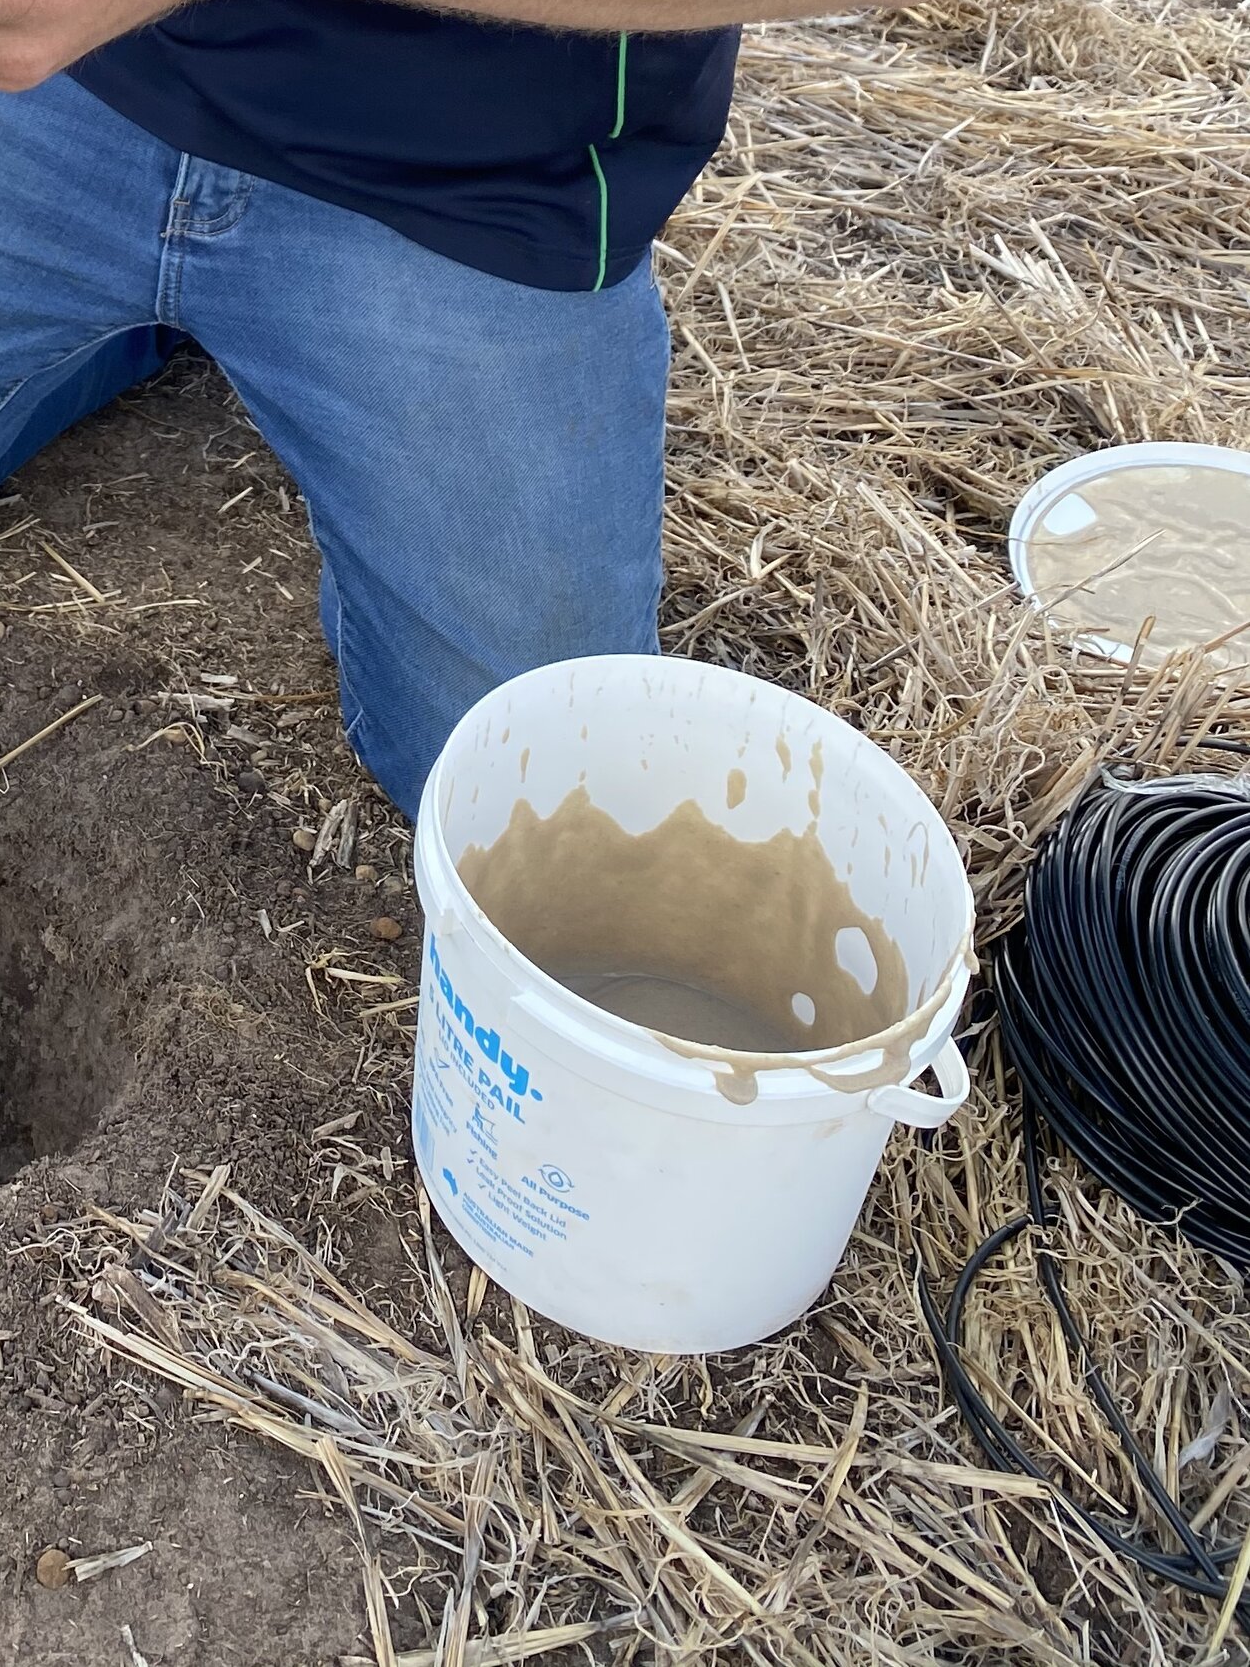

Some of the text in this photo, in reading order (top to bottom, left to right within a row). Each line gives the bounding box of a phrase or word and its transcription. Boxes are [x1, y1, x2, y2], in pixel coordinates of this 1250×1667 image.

[436, 1001, 475, 1074] LITRE
[478, 1067, 526, 1125] PAIL
[450, 1050, 495, 1110] INCLUDED
[466, 1120, 498, 1160] Fishing
[463, 1191, 508, 1238] AUSTRALIAN
[509, 1235, 534, 1258] MADE
[488, 1190, 547, 1241] Light Weight
[497, 1187, 523, 1212] Proof
[525, 1209, 567, 1240] Solution
[501, 1178, 521, 1199] Peel
[523, 1196, 547, 1217] Back
[550, 1214, 566, 1228] Lid
[521, 1175, 590, 1222] All Purpose
